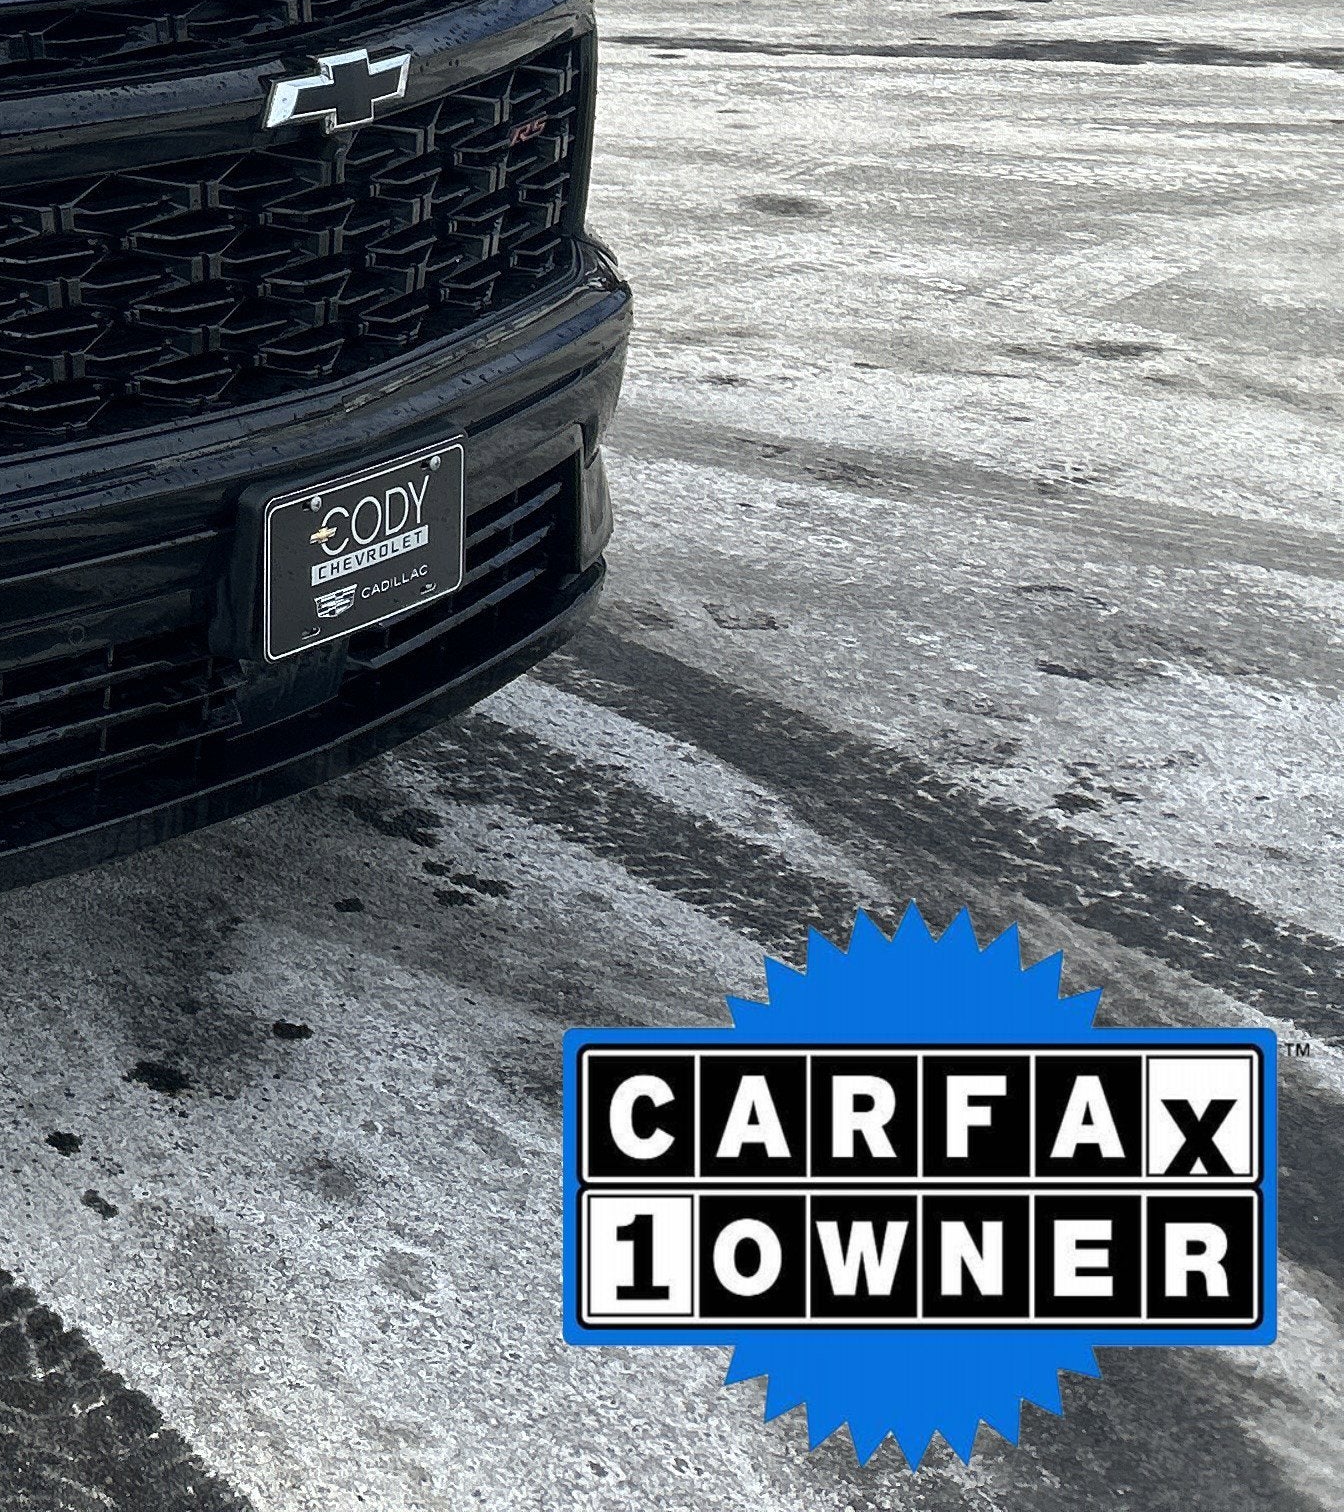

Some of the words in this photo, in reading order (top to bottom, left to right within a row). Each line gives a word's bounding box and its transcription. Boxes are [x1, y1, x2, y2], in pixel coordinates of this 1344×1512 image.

[510, 115, 548, 147] RS
[321, 474, 430, 556] CODY
[318, 529, 423, 580] CHEVROLET
[361, 564, 429, 600] CADILLAC
